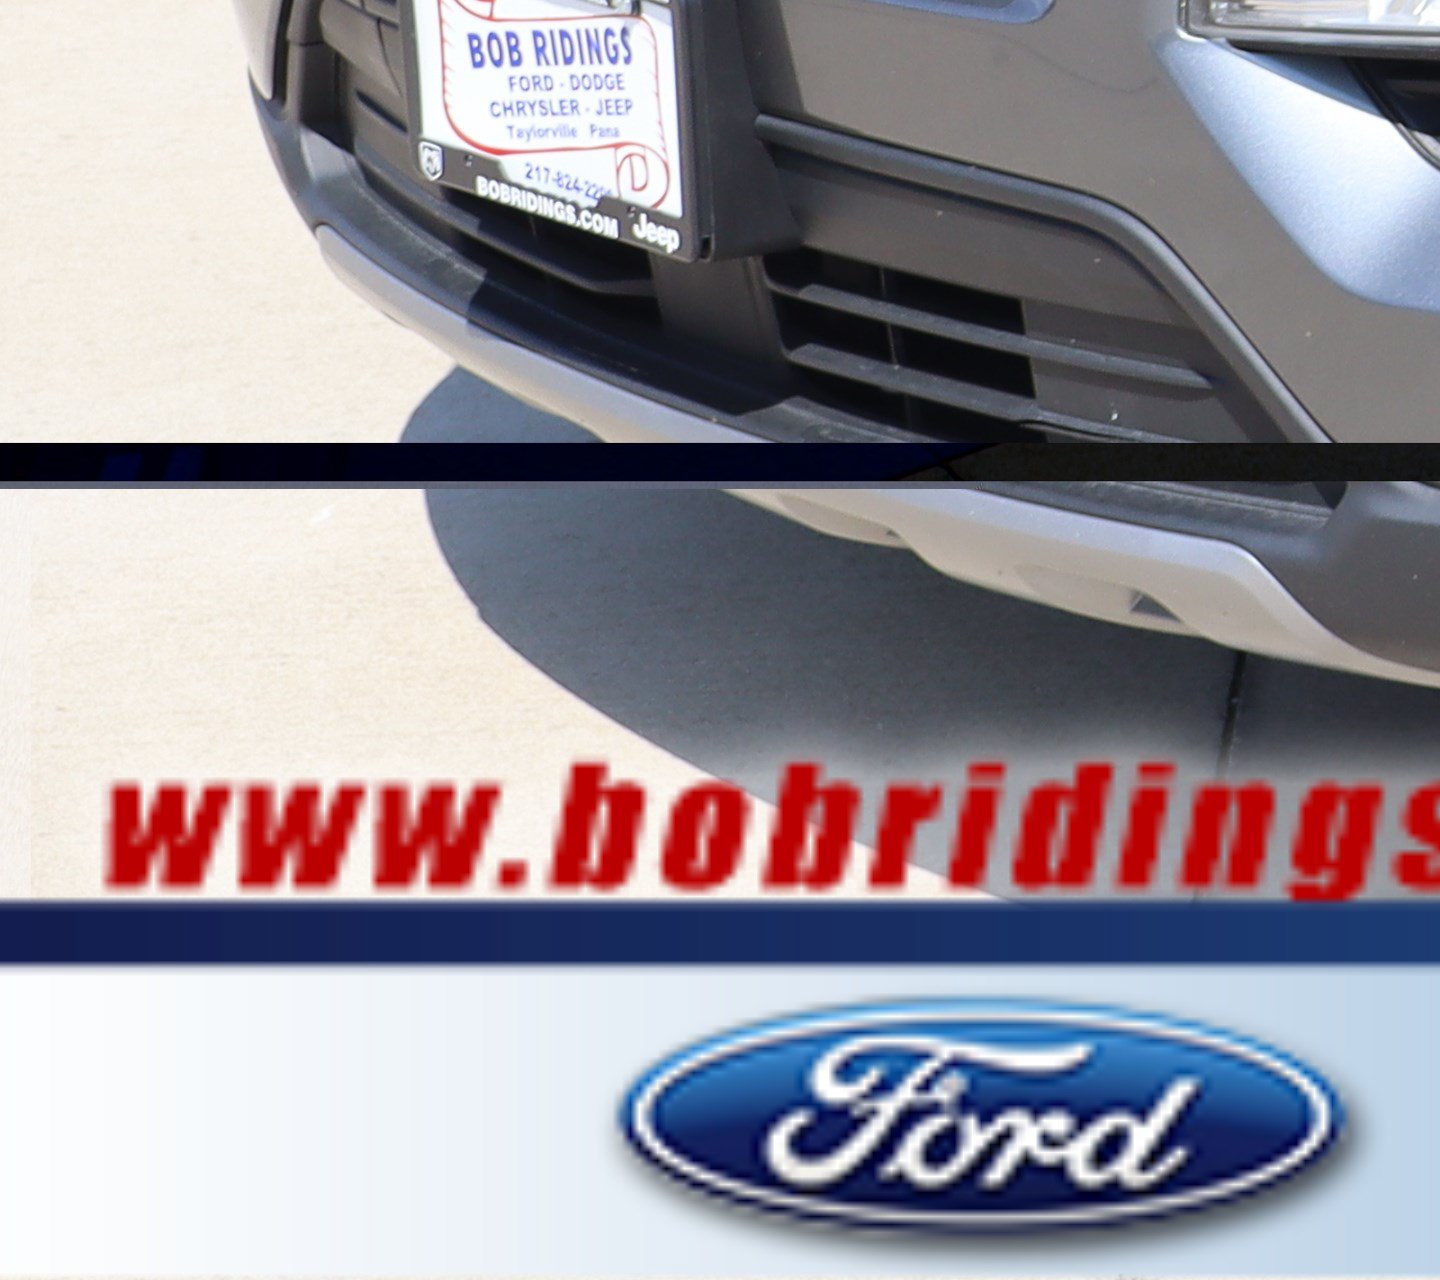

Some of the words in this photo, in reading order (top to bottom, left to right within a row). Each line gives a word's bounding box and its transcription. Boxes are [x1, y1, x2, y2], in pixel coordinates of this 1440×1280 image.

[467, 30, 524, 69] BOB
[532, 25, 633, 67] RIDINGS
[508, 73, 555, 92] FORD
[569, 72, 626, 92] DODGE
[489, 98, 581, 119] CHRYSLER
[594, 97, 634, 117] JEEP
[506, 124, 578, 143] Taylorville
[589, 123, 621, 139] Pana
[474, 175, 620, 240] BOBRIDINGS.COM
[631, 212, 681, 255] Jeep
